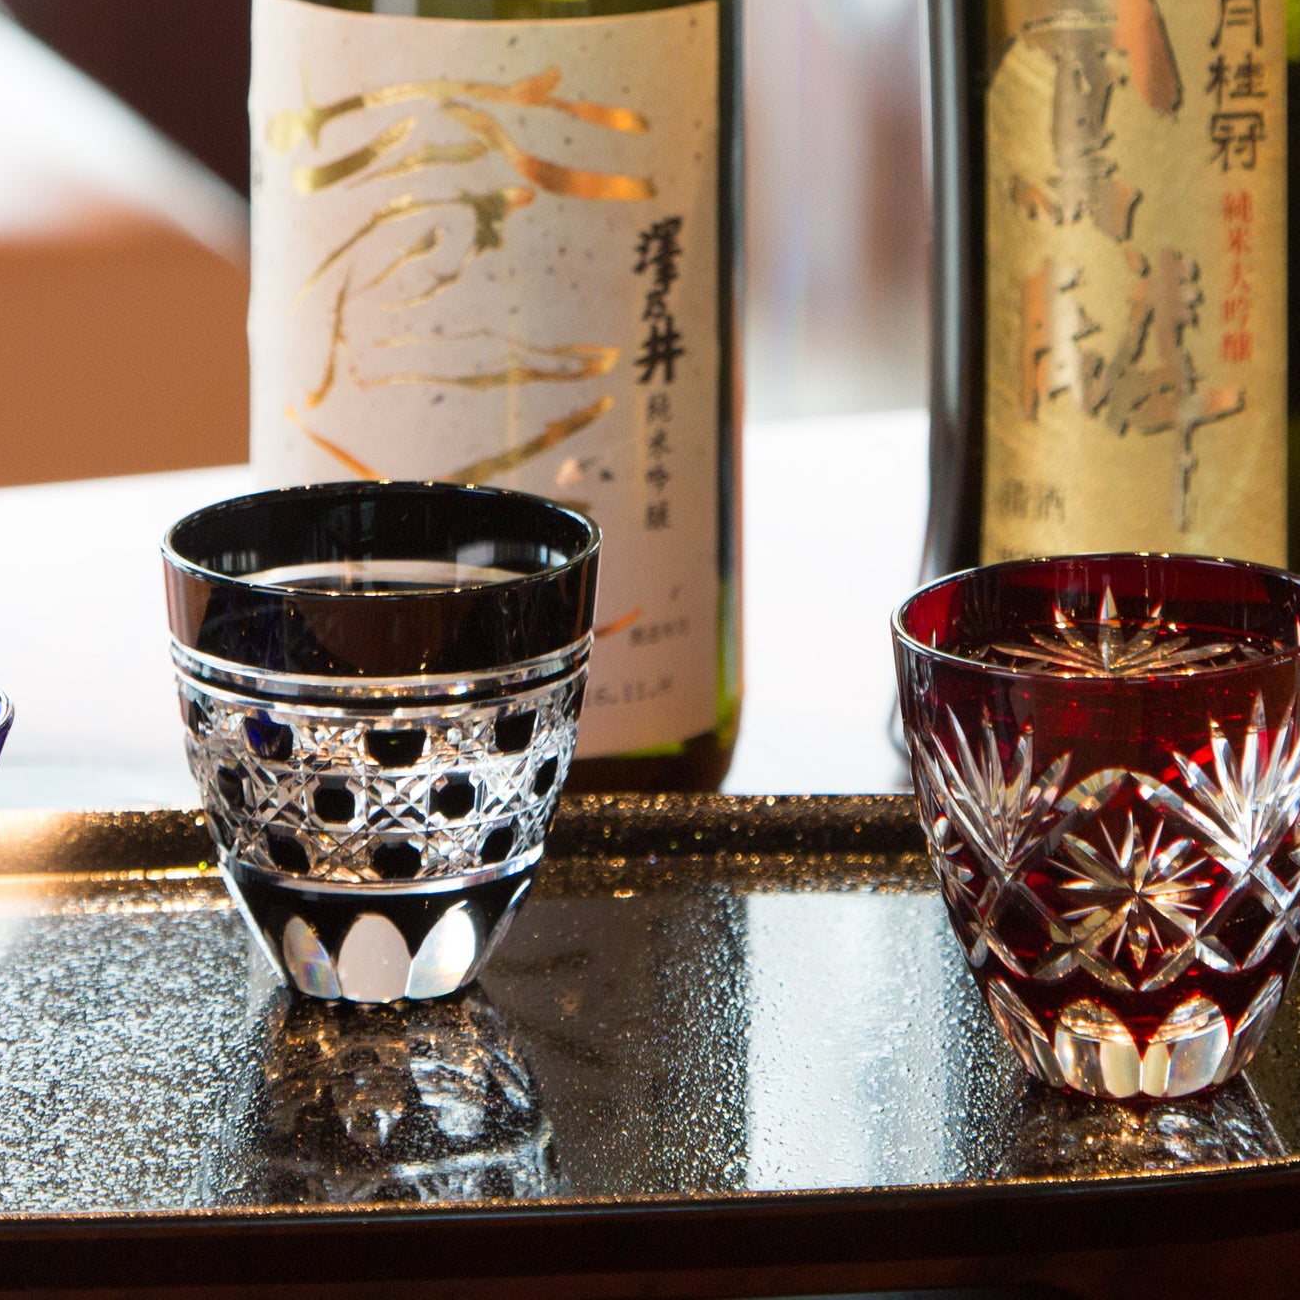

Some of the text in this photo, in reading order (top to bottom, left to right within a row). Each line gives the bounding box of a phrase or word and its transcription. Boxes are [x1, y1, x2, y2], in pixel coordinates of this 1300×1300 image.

[633, 215, 684, 385] 澤乃井
[1222, 189, 1254, 364] 純米大吟醸
